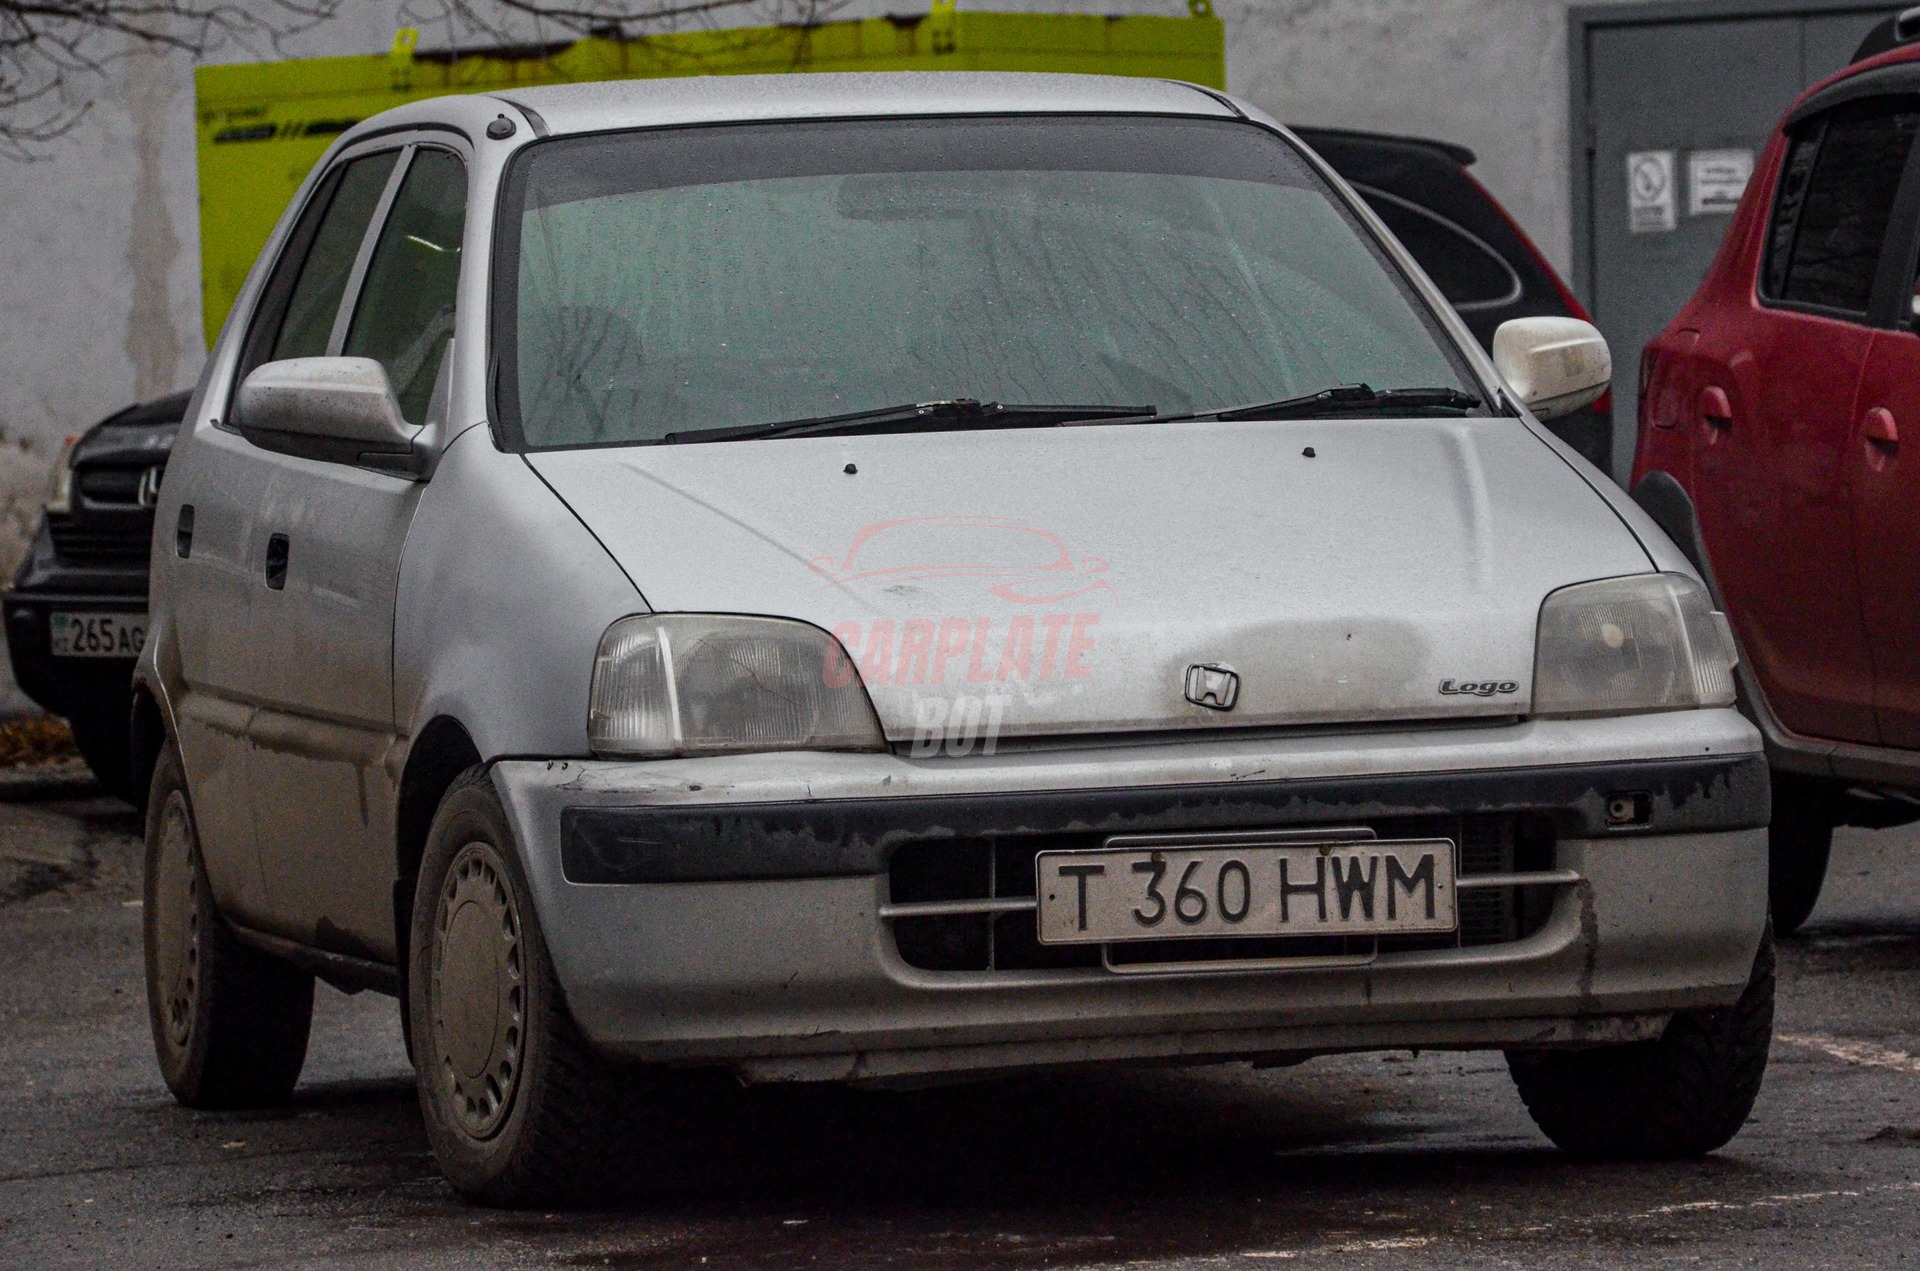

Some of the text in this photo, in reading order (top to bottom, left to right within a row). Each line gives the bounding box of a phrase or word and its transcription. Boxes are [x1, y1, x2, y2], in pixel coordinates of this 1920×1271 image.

[71, 618, 115, 651] 265
[1440, 679, 1519, 696] Logo
[1058, 853, 1436, 931] T 360 HWM
